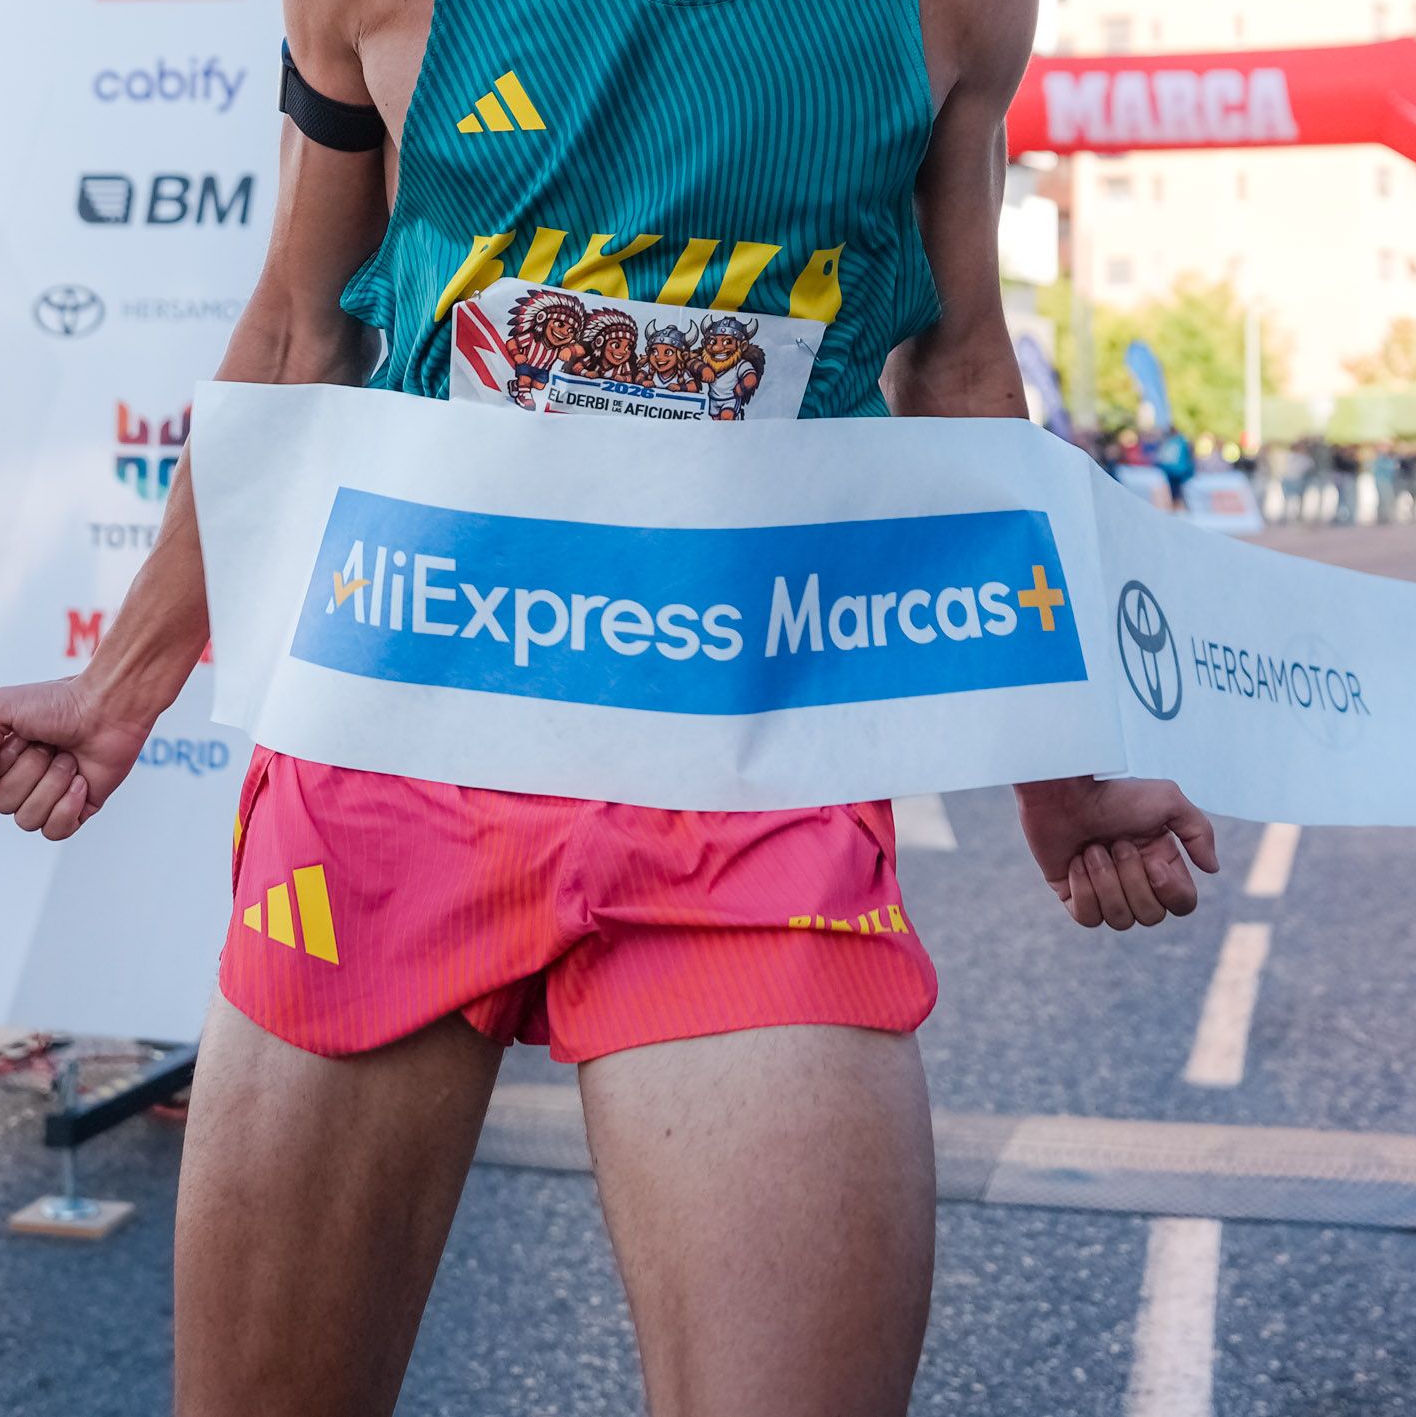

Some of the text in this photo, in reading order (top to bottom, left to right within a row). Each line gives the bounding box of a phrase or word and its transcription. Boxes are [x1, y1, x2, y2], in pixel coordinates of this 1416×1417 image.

[91, 59, 246, 114] cabify
[1043, 69, 1297, 142] MARCA
[146, 173, 255, 225] BM
[121, 296, 243, 322] HERSAMO
[548, 387, 563, 403] EL
[566, 393, 609, 411] DERBI
[600, 381, 655, 398] 2026
[326, 540, 744, 667] AliExpress
[1190, 634, 1371, 717] HERSAMOTOR
[139, 737, 230, 777] DRID
